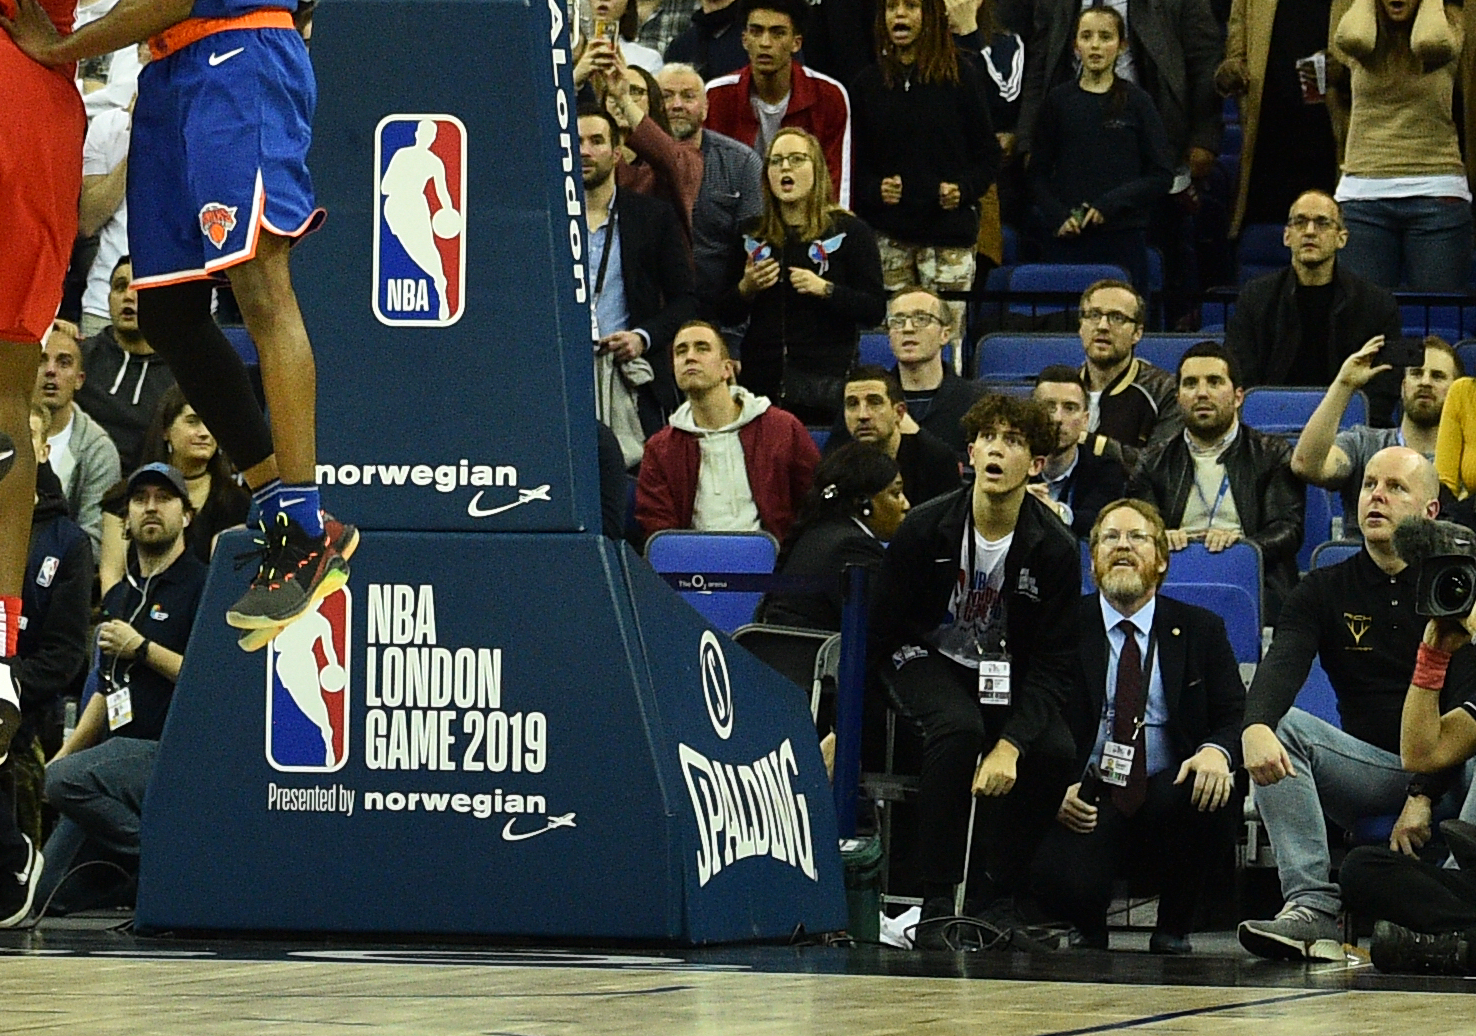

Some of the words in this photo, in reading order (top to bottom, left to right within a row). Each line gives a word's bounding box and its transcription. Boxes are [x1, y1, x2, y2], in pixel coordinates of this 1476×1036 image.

[386, 278, 429, 312] NBA
[315, 459, 518, 492] norwegian
[367, 583, 437, 645] NBA
[365, 647, 502, 709] LONDON
[365, 708, 456, 771] GAME
[462, 710, 547, 773] 2019
[268, 782, 337, 812] Presented
[338, 783, 356, 817] by
[364, 787, 546, 818] norwegian
[679, 738, 818, 888] SPALDING
